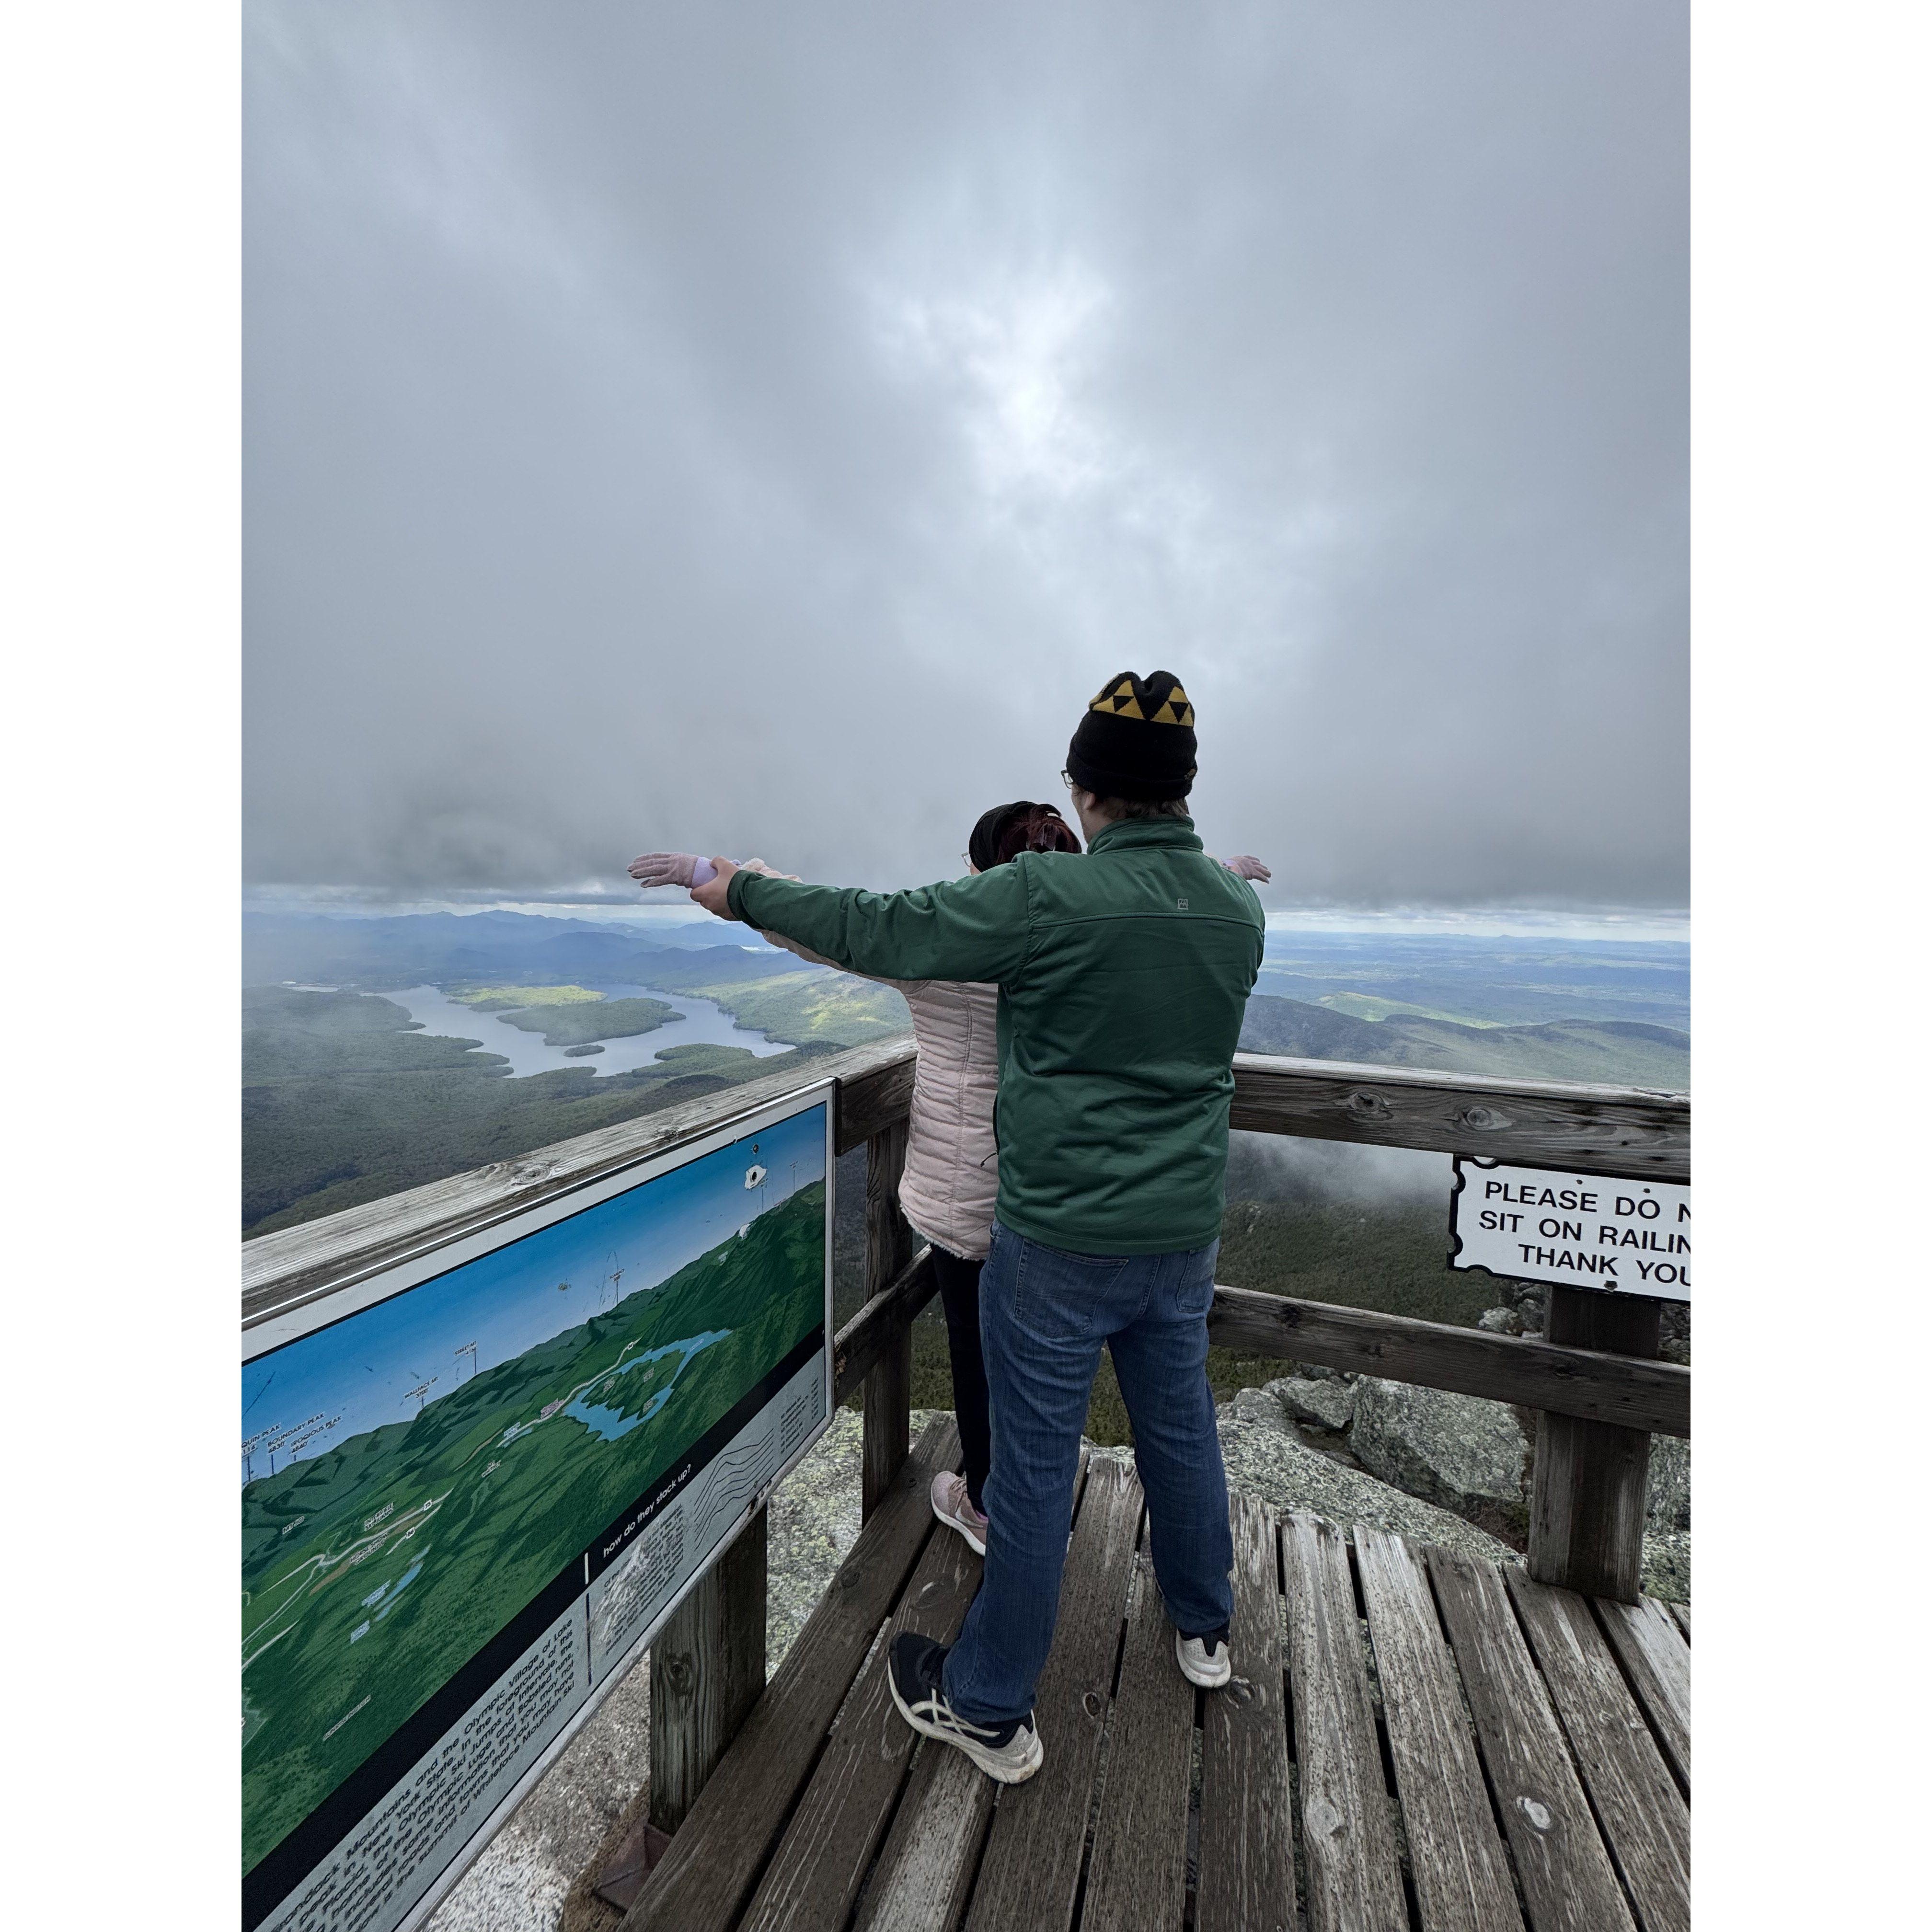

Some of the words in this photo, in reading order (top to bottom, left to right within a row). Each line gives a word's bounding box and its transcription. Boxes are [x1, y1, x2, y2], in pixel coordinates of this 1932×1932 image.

[1479, 1210, 1524, 1233] SIT
[1539, 1219, 1582, 1241] ON
[1598, 1225, 1690, 1254] RAILIN
[1485, 1181, 1598, 1213] PLEASE
[1615, 1196, 1660, 1219] DO
[1518, 1243, 1619, 1276] THANK
[1635, 1260, 1690, 1287] YOU
[262, 1424, 280, 1438] PEAK
[268, 1422, 306, 1447] BOUNDARY
[308, 1413, 324, 1426] PEAK
[291, 1426, 324, 1447] IROQIOUS
[325, 1415, 342, 1428] PEAK
[404, 1381, 430, 1399] WALLFACE
[603, 1534, 622, 1557] how
[624, 1521, 636, 1537] do
[637, 1502, 655, 1524] they
[656, 1480, 677, 1504] stack
[678, 1464, 691, 1483] up?
[331, 1874, 370, 1920] home
[376, 1852, 388, 1871] of
[393, 1828, 412, 1852] the
[417, 1772, 463, 1824] Olympic
[469, 1741, 492, 1770] Luge
[496, 1714, 514, 1738] and
[518, 1673, 552, 1714] Bobsled
[555, 1653, 573, 1674] runs,
[347, 1789, 410, 1860] Mountains
[415, 1758, 438, 1786] and
[443, 1738, 459, 1758] the
[464, 1690, 505, 1735] Olympic
[509, 1655, 539, 1687] Village
[542, 1639, 551, 1653] of
[554, 1620, 572, 1642] Lake
[362, 1823, 390, 1858] New
[396, 1790, 421, 1818] York
[427, 1757, 456, 1789] State.
[462, 1738, 471, 1751] In
[476, 1717, 491, 1736] the
[496, 1658, 544, 1714] foreground
[548, 1645, 556, 1658] of
[560, 1630, 572, 1646] this
[373, 1836, 393, 1860] the
[399, 1778, 446, 1831] Olympic
[451, 1754, 466, 1775] Ski
[470, 1717, 502, 1755] Jumps
[506, 1702, 515, 1715] at
[519, 1660, 557, 1702] Intervale,
[561, 1641, 573, 1656] the
[396, 1865, 414, 1889] the
[418, 1814, 458, 1865] summit
[460, 1799, 471, 1815] of
[473, 1745, 519, 1799] Whiteface
[523, 1697, 561, 1744] Mountain
[564, 1680, 574, 1697] Ski
[398, 1835, 430, 1875] roads
[434, 1804, 455, 1833] and
[460, 1769, 488, 1804] towns
[492, 1743, 509, 1767] that
[513, 1722, 529, 1744] you
[533, 1697, 552, 1721] may
[554, 1672, 574, 1697] have
[345, 1858, 398, 1921] includes
[402, 1817, 434, 1856] some
[438, 1749, 495, 1816] information
[499, 1723, 517, 1748] that
[521, 1702, 536, 1725] you
[540, 1678, 558, 1702] may
[562, 1659, 574, 1678] not
